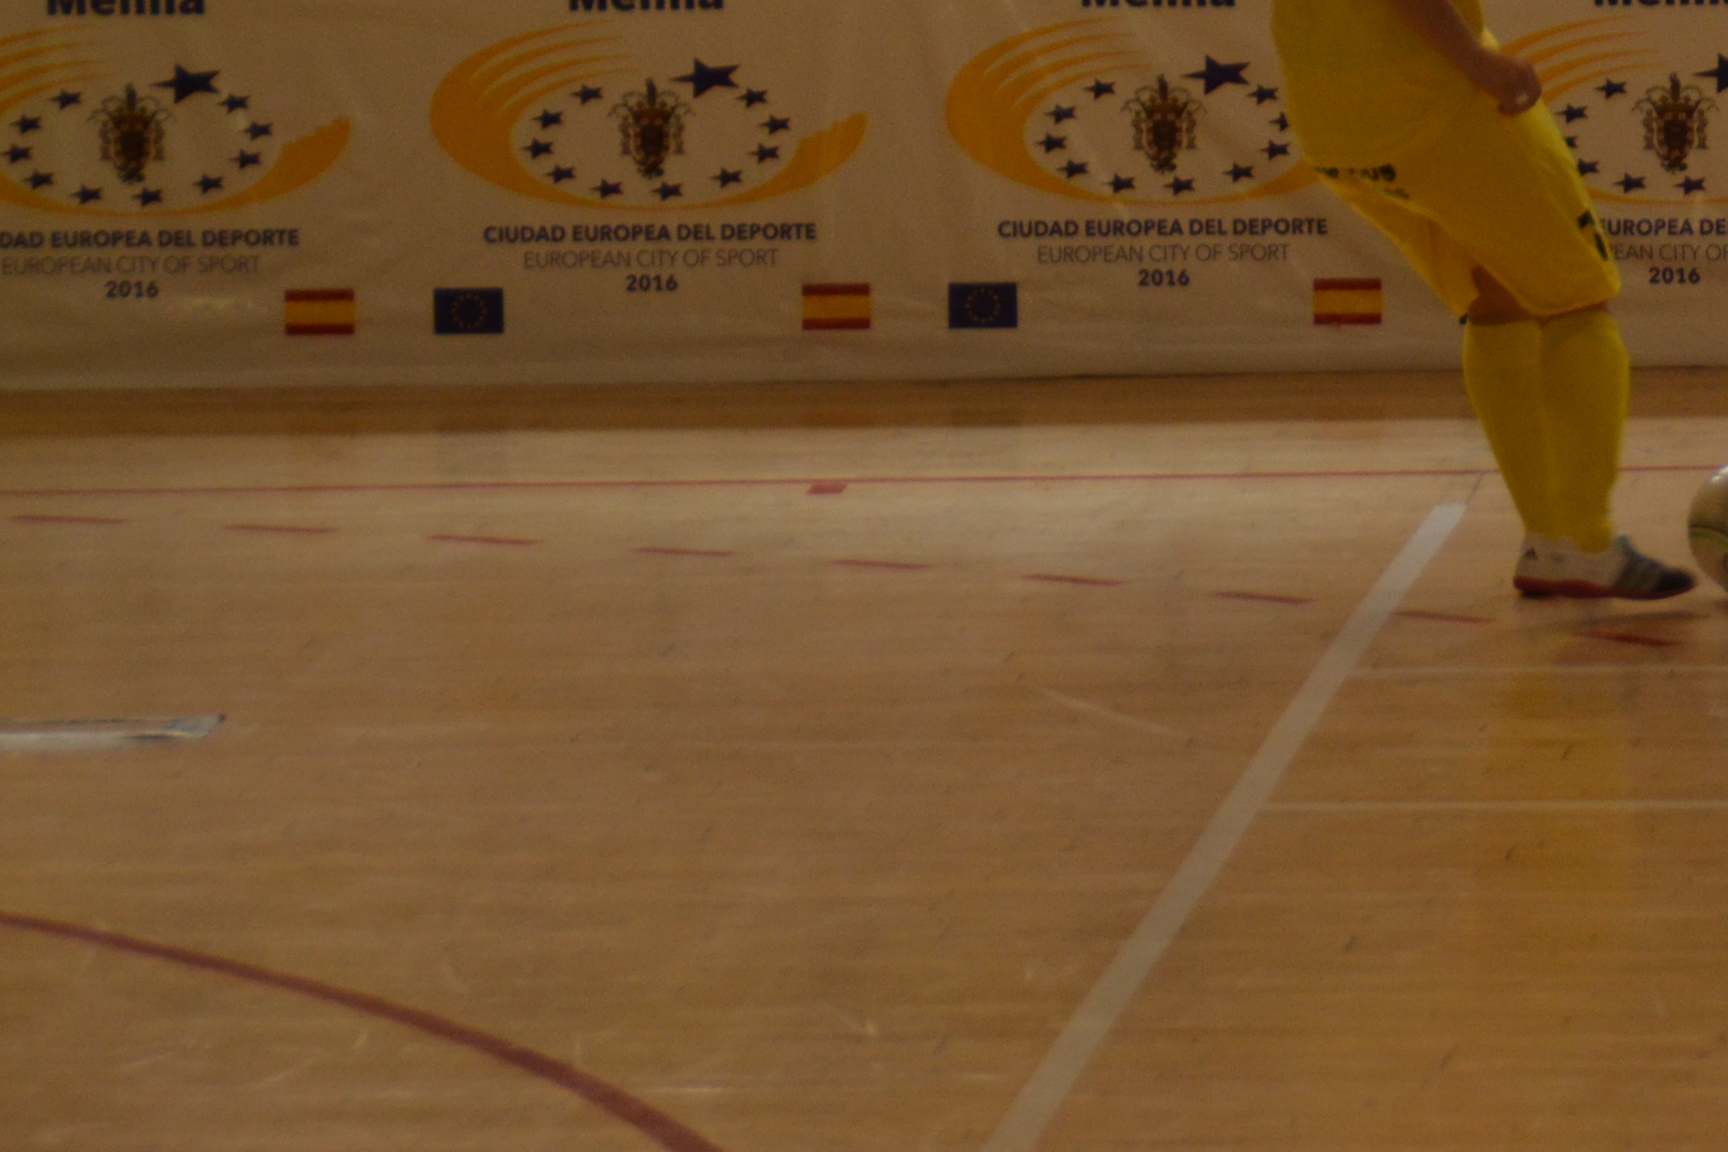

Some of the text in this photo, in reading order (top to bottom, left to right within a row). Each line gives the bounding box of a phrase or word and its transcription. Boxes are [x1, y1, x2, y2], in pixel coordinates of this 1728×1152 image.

[484, 222, 816, 244] CIUDAD EUROPEA DEL DEPORTE
[998, 217, 1328, 238] CIUDAD EUROPEA DEL DEPORTE
[0, 228, 299, 248] DAD EUROPEA DEL DEPORTE
[524, 248, 778, 269] EUROPEAN CITY OF SPORT
[1037, 243, 1289, 264] EUROPEAN CITY OF SPORT
[1659, 243, 1699, 262] CITY
[3, 254, 260, 275] EUROPEAN CITY OF SPORT
[626, 275, 678, 292] 2016
[1138, 269, 1190, 286] 2016
[1649, 266, 1701, 284] 2016
[105, 280, 159, 298] 2016
